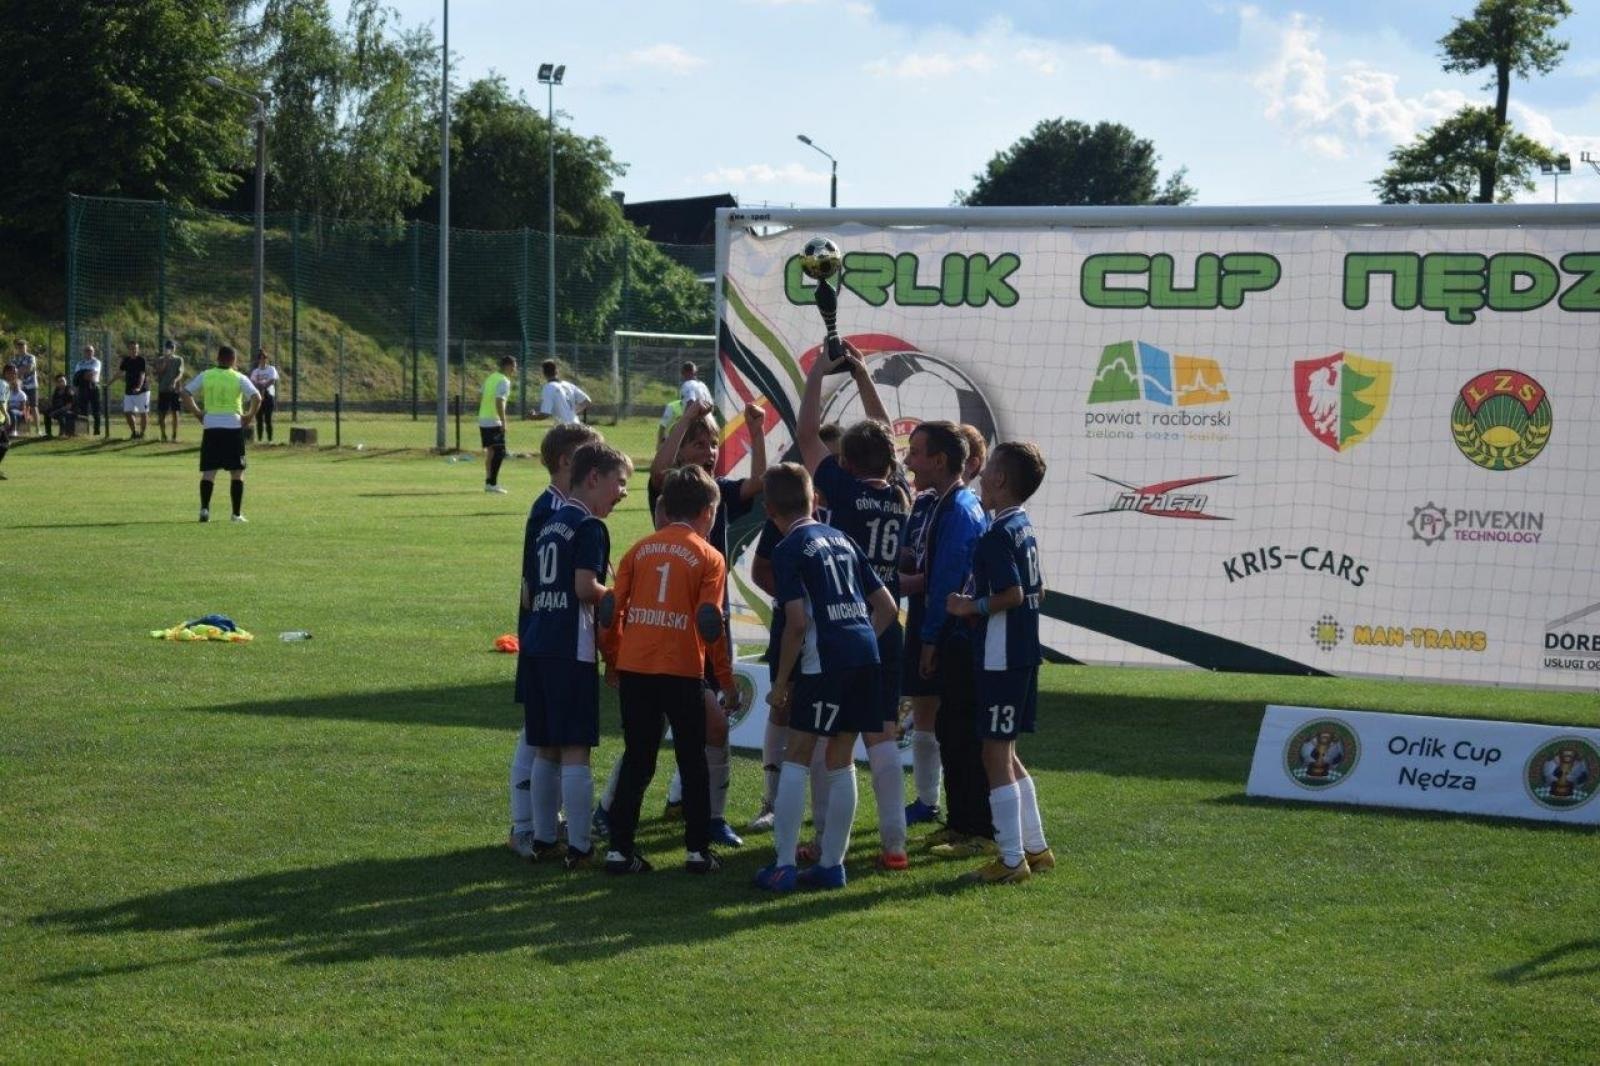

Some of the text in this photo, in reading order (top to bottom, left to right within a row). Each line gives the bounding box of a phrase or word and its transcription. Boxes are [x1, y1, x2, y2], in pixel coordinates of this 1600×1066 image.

[1080, 251, 1281, 310] CUP
[1467, 375, 1536, 402] LZS
[1084, 409, 1231, 427] powiat raciborski
[1085, 428, 1134, 440] zielona
[1454, 509, 1544, 531] PIVEXIN
[865, 517, 900, 561] 16
[1454, 529, 1542, 543] TECHNOLOGY
[537, 541, 558, 585] 10
[823, 553, 855, 595] 17
[1222, 546, 1369, 587] KRIS-CARS
[656, 562, 671, 603] 1
[1353, 625, 1487, 651] MAN-TRANS
[812, 700, 840, 732] 17
[988, 704, 1016, 735] 13
[1388, 735, 1502, 767] Orlik Cup
[1398, 766, 1476, 791] Nędza
